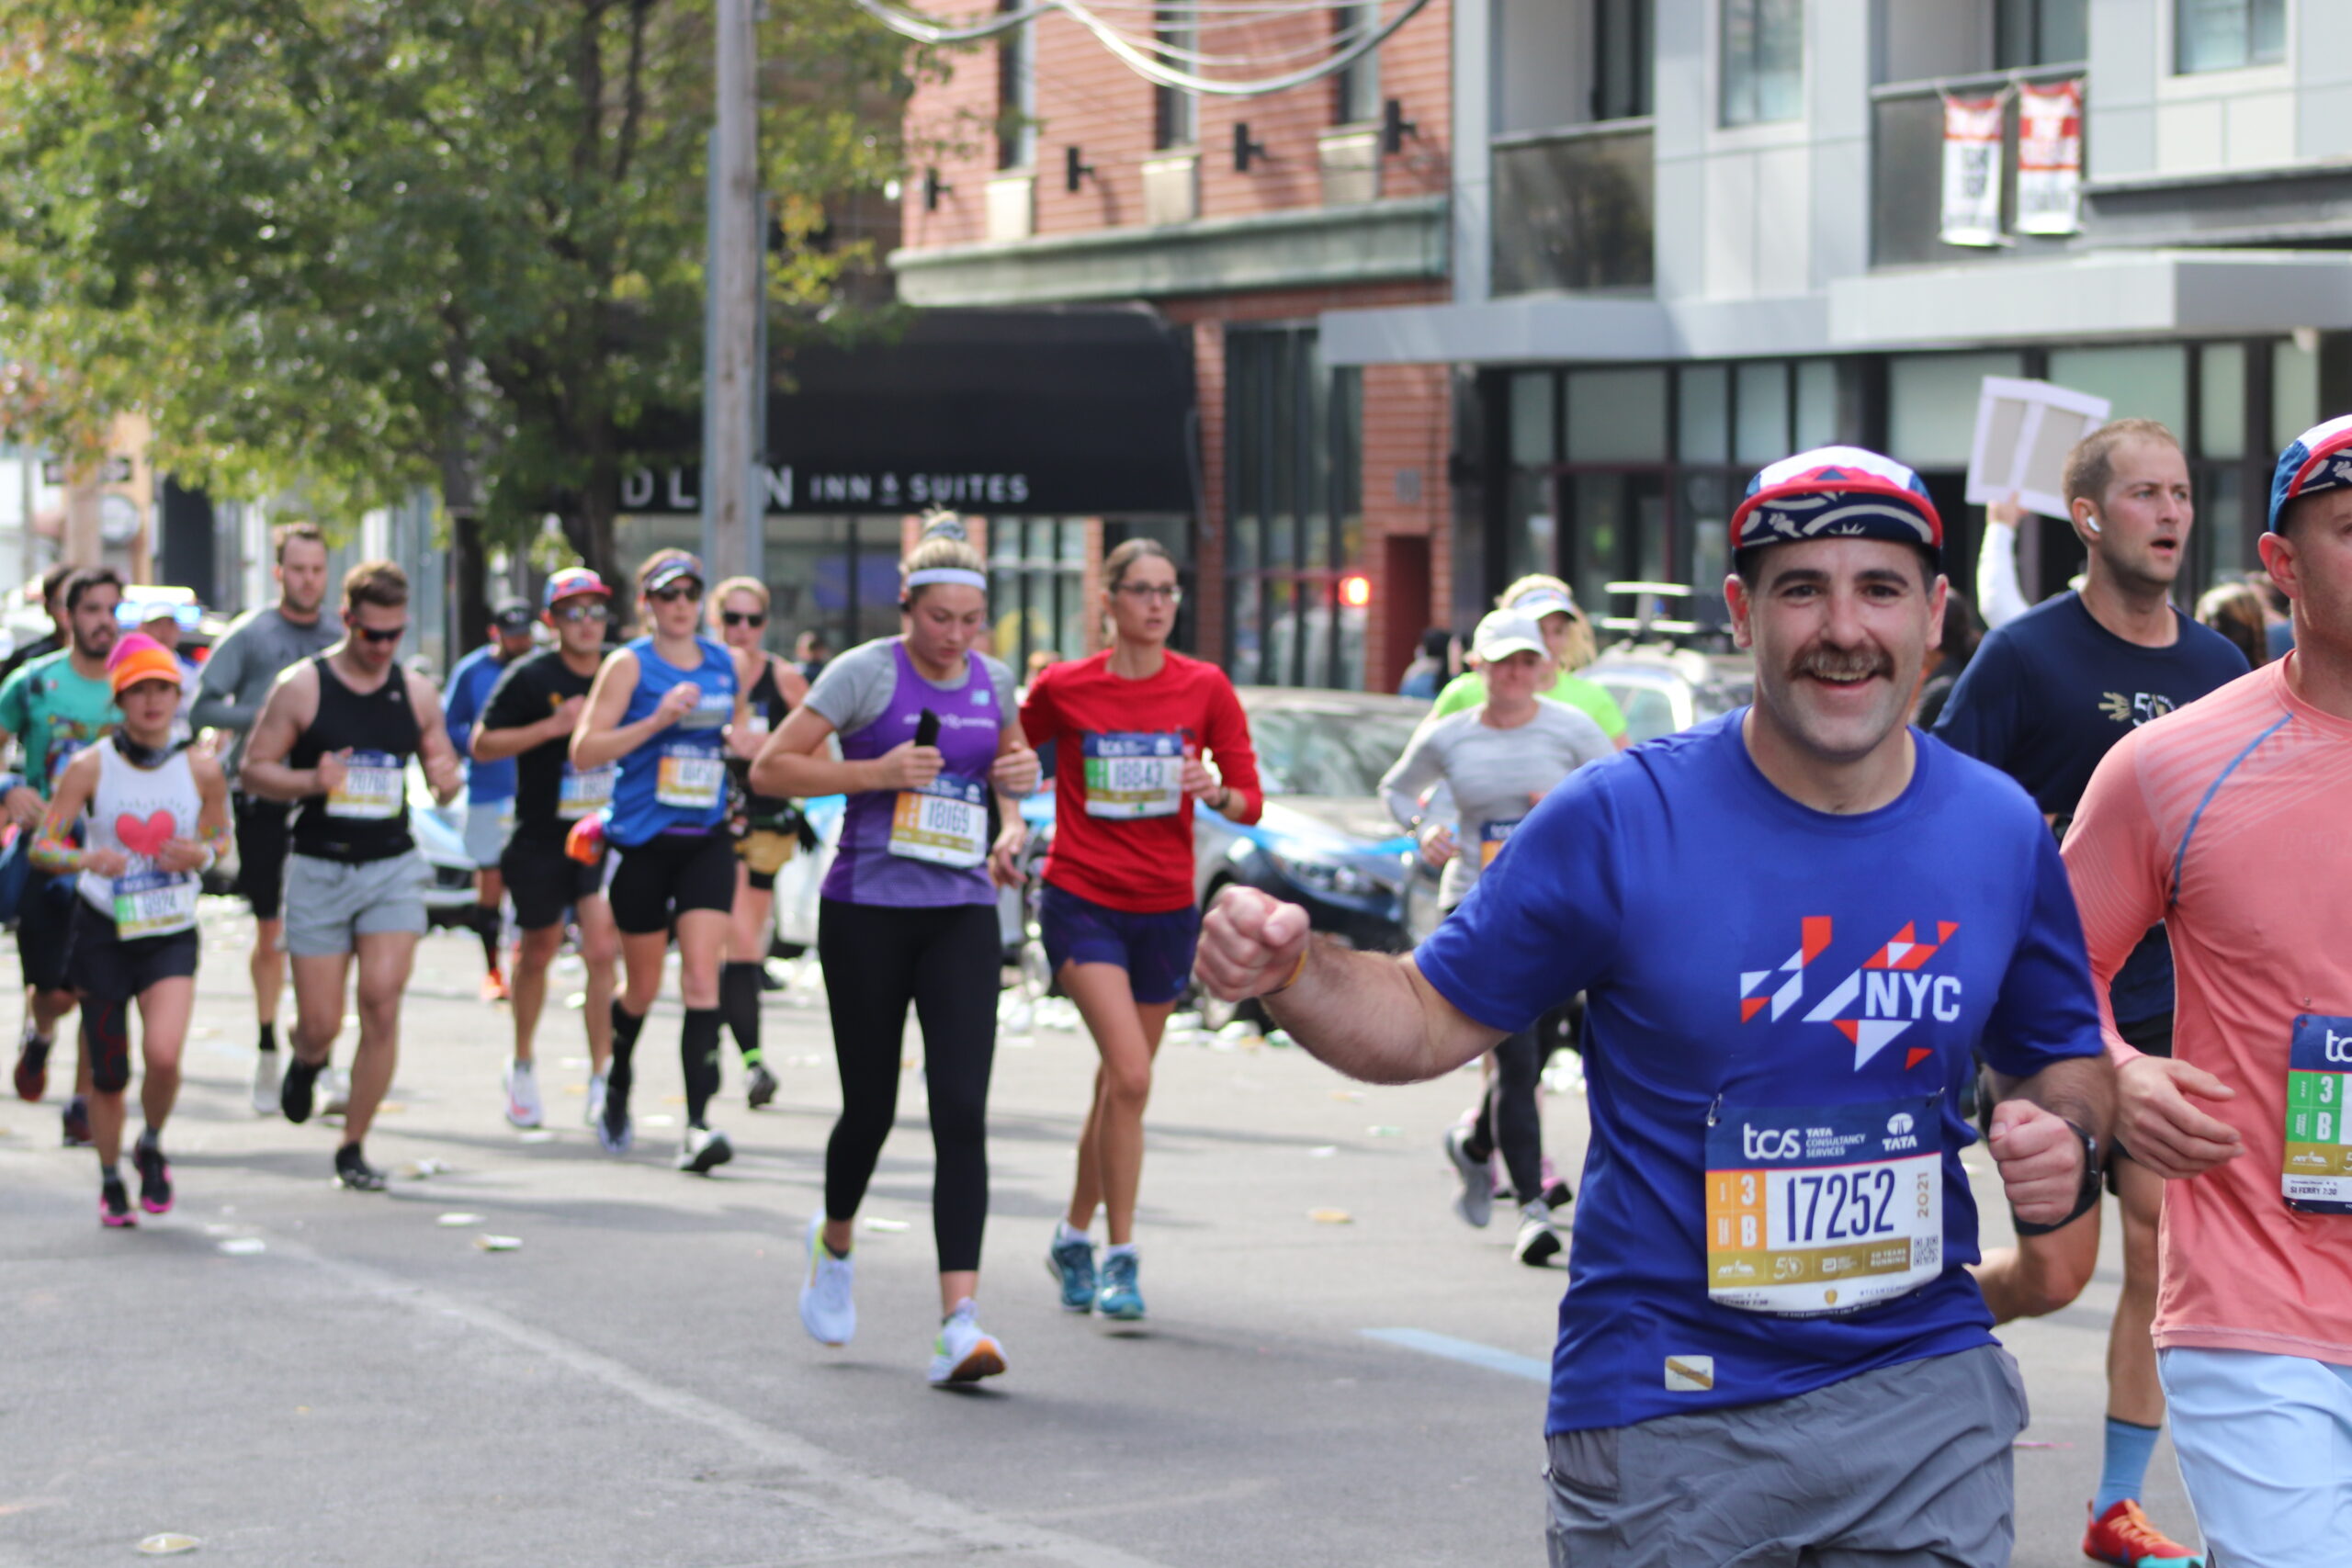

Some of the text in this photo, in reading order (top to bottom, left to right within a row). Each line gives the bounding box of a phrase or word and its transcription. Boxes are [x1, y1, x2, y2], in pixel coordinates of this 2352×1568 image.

[810, 474, 871, 502] INN
[910, 473, 1029, 503] SUITES
[1865, 971, 1962, 1021] NYC
[2320, 1076, 2334, 1103] 3
[1743, 1122, 1801, 1159] tcs
[1805, 1134, 1866, 1147] CONSULTANCY
[1806, 1128, 1833, 1138] TATA
[2317, 1111, 2333, 1141] B
[1805, 1146, 1846, 1158] SERVICES
[1883, 1134, 1917, 1152] TATA
[1740, 1174, 1756, 1206] 3
[1917, 1172, 1929, 1218] 2021
[1787, 1168, 1895, 1243] 17252
[1741, 1215, 1758, 1247] B
